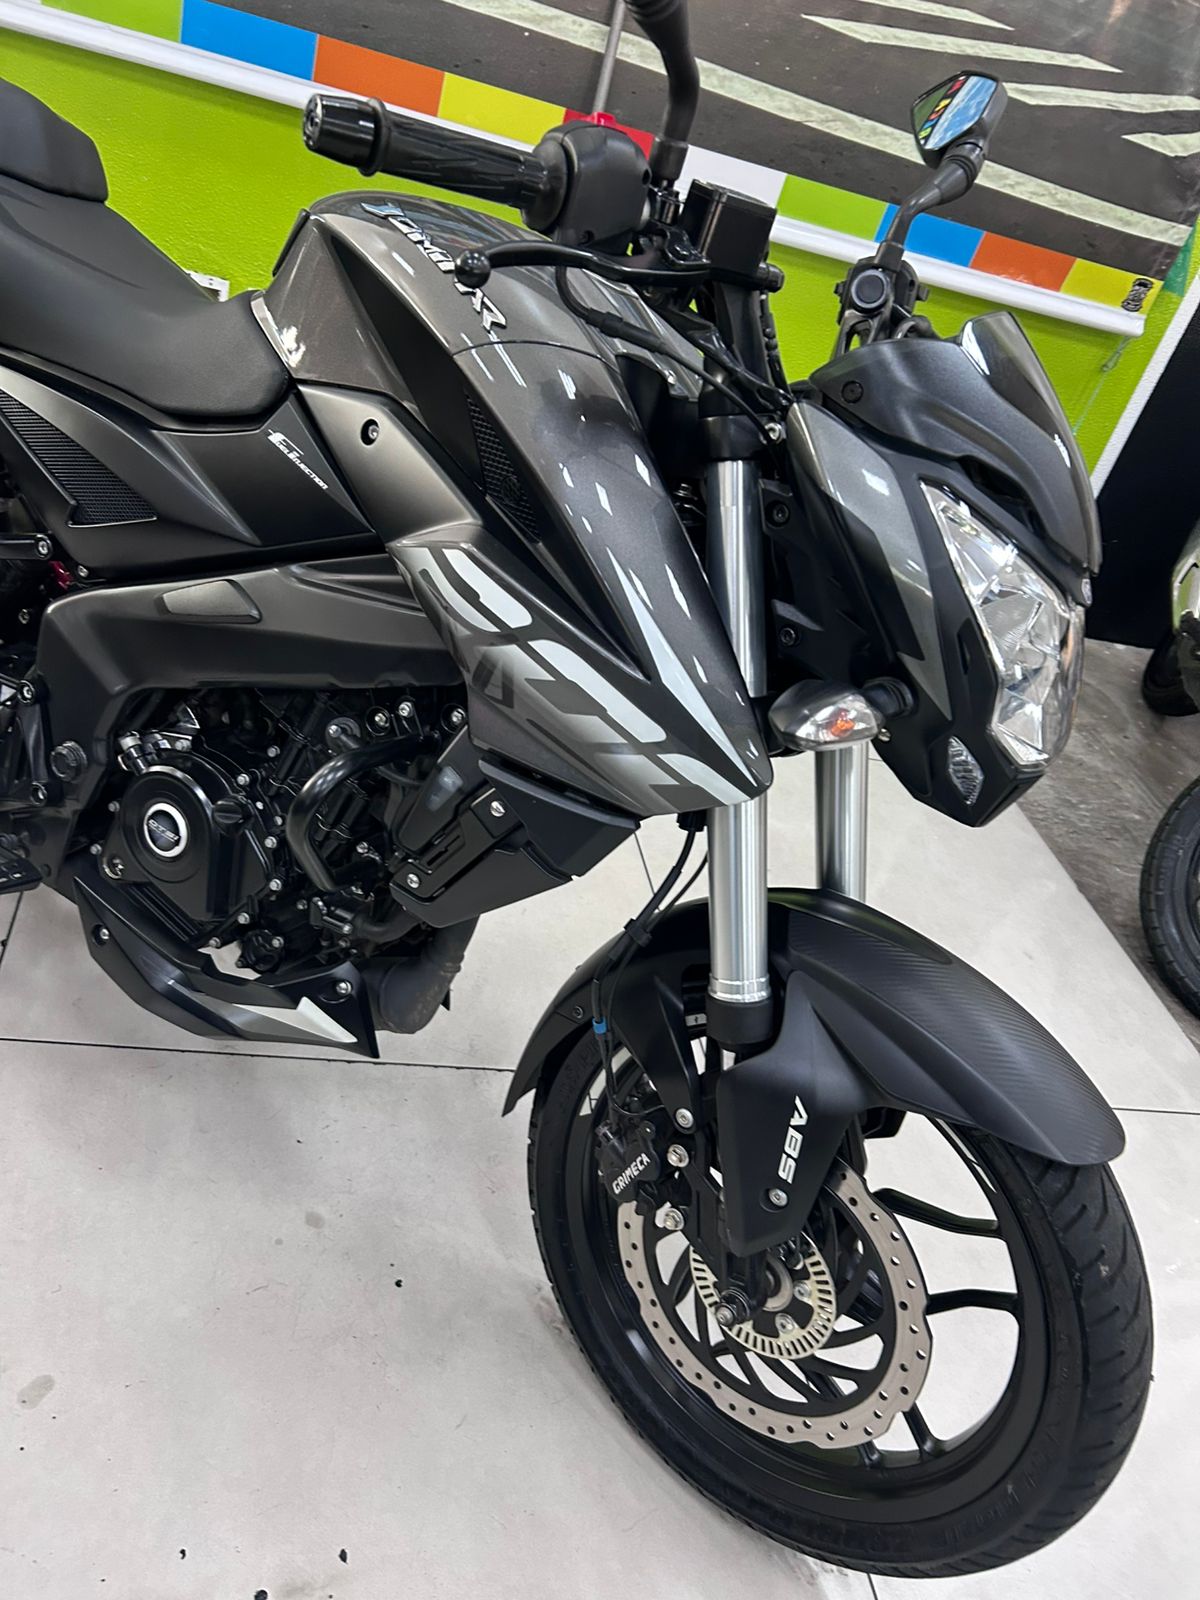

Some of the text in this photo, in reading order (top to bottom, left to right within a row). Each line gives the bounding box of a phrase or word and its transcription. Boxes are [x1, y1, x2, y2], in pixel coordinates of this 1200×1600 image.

[360, 201, 507, 331] DOMIAR
[612, 1152, 651, 1195] GRIMECA
[777, 1094, 809, 1185] ABS
